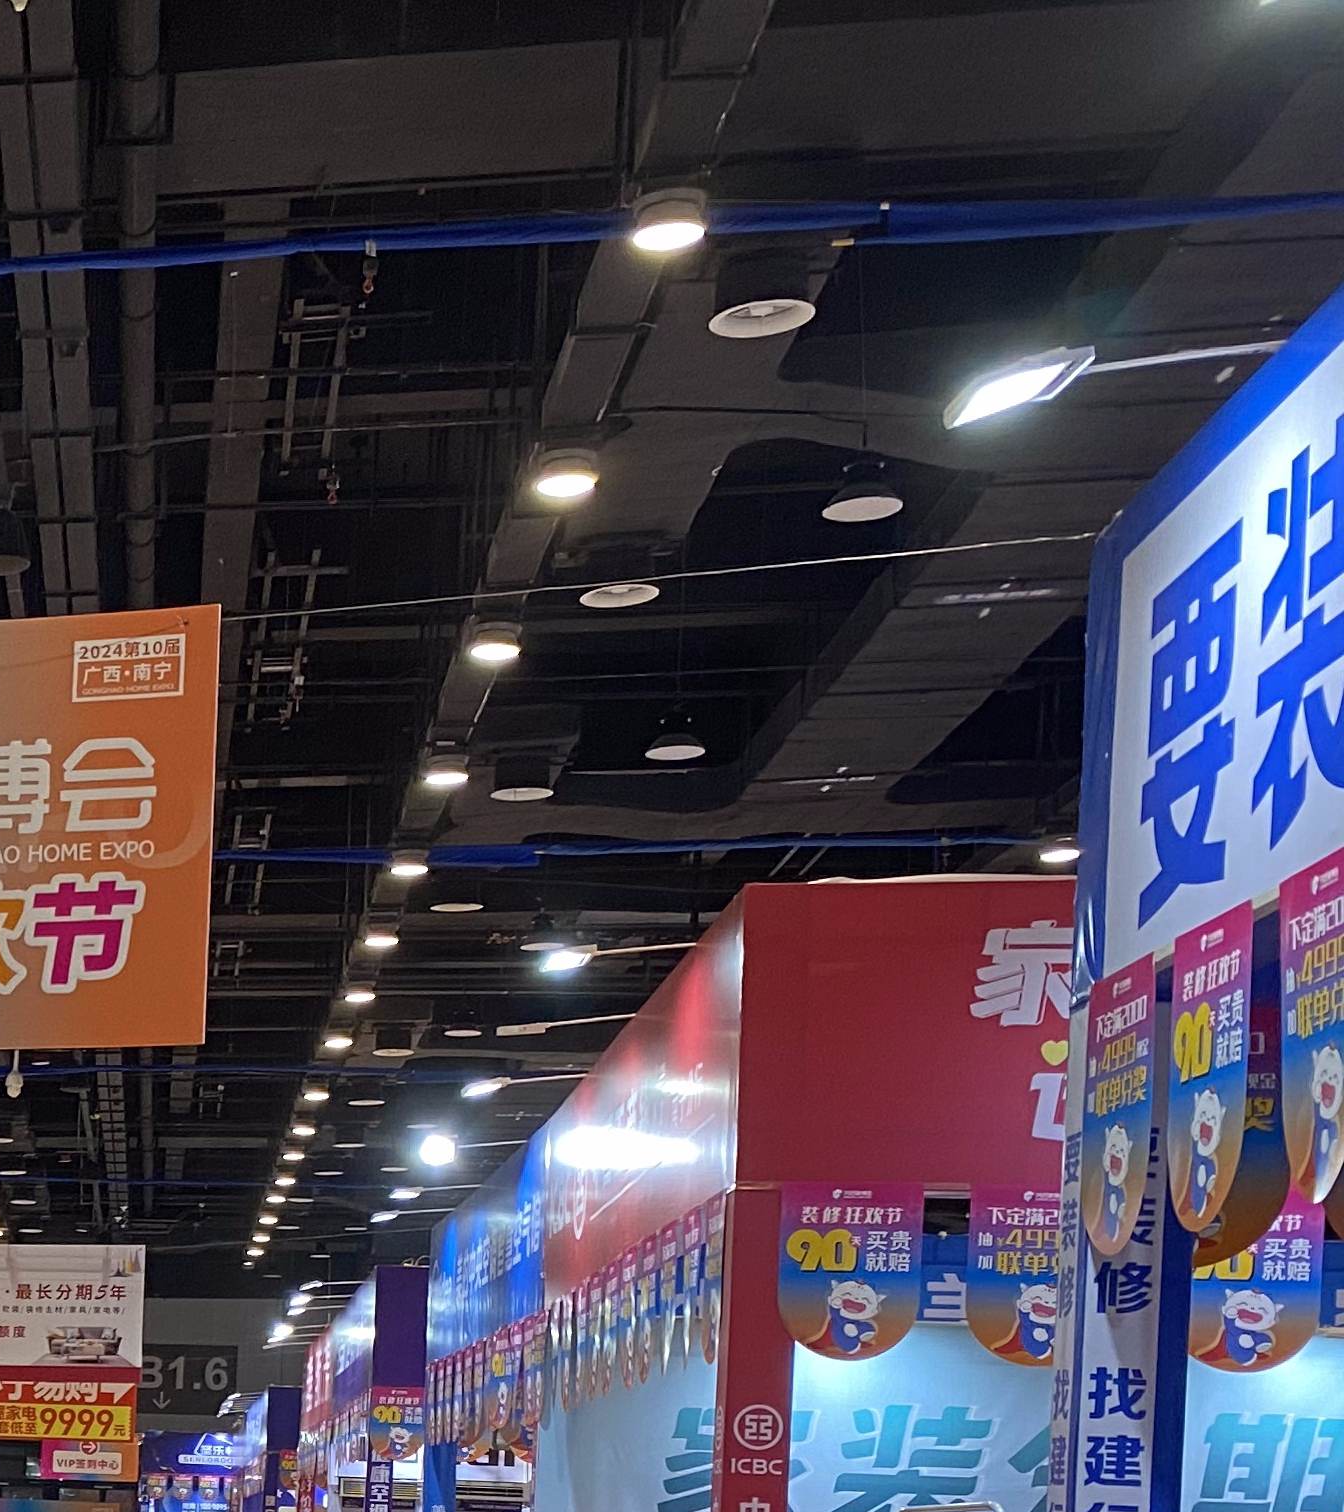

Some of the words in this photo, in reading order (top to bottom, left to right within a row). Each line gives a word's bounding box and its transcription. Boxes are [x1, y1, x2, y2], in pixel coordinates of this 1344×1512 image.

[78, 638, 181, 661] 2024第10届
[82, 661, 173, 686] 广西·南宁
[27, 844, 94, 867] HOME
[98, 840, 156, 862] EXPO
[1182, 949, 1242, 1003] 装修狂欢节
[1216, 989, 1245, 1032] 买贵
[801, 1205, 904, 1225] 装修狂欢节
[866, 1231, 912, 1251] 买贵
[1263, 1237, 1312, 1260] 买贵
[865, 1252, 911, 1273] 就赔
[1262, 1260, 1311, 1283] 就赔
[730, 1457, 783, 1475] ICBC
